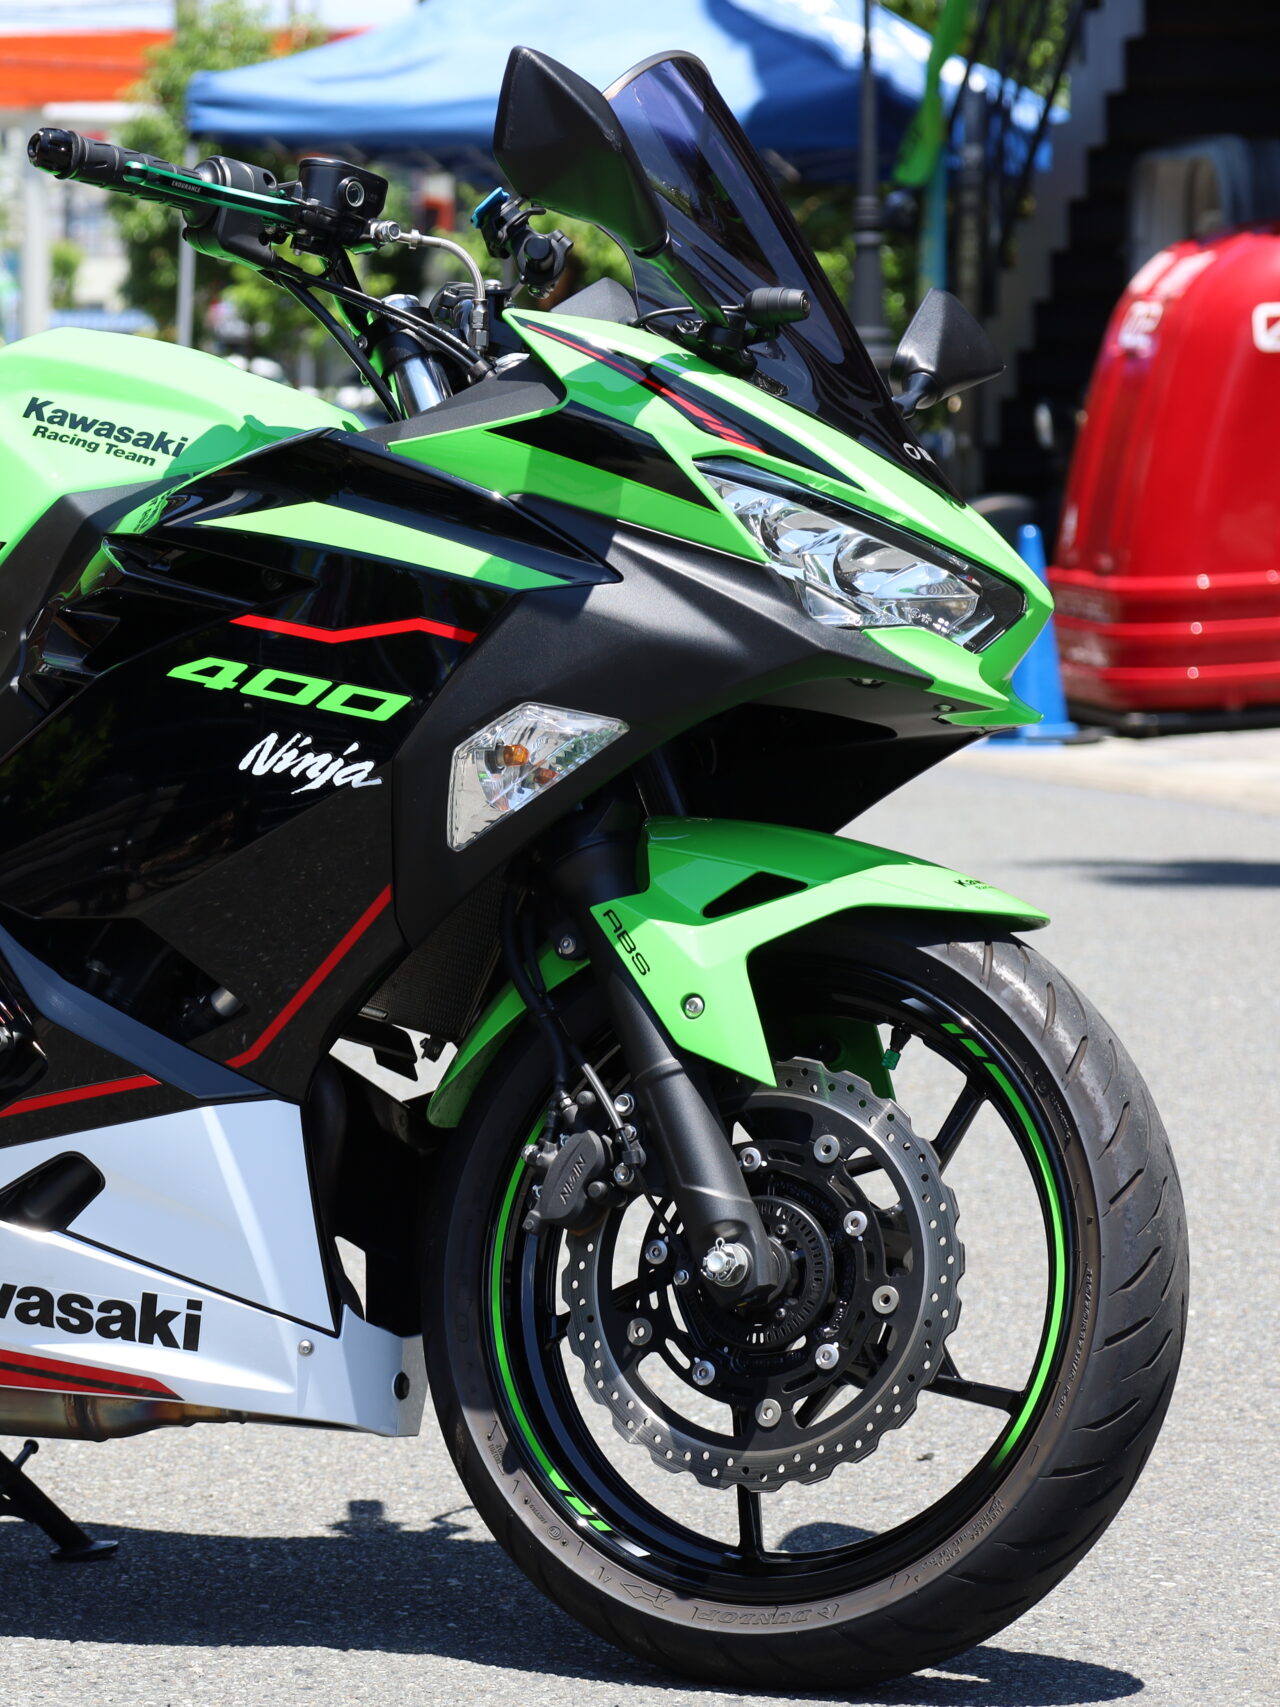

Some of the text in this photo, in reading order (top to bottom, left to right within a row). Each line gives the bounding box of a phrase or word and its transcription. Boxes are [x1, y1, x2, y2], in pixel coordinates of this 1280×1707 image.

[171, 180, 201, 193] ENDURANCE
[22, 396, 189, 458] Kawasaki
[32, 425, 156, 467] Racing Team
[166, 656, 412, 722] 400
[238, 732, 383, 795] Ninja
[602, 909, 651, 976] ABS
[696, 1608, 812, 1625] DUNLOP
